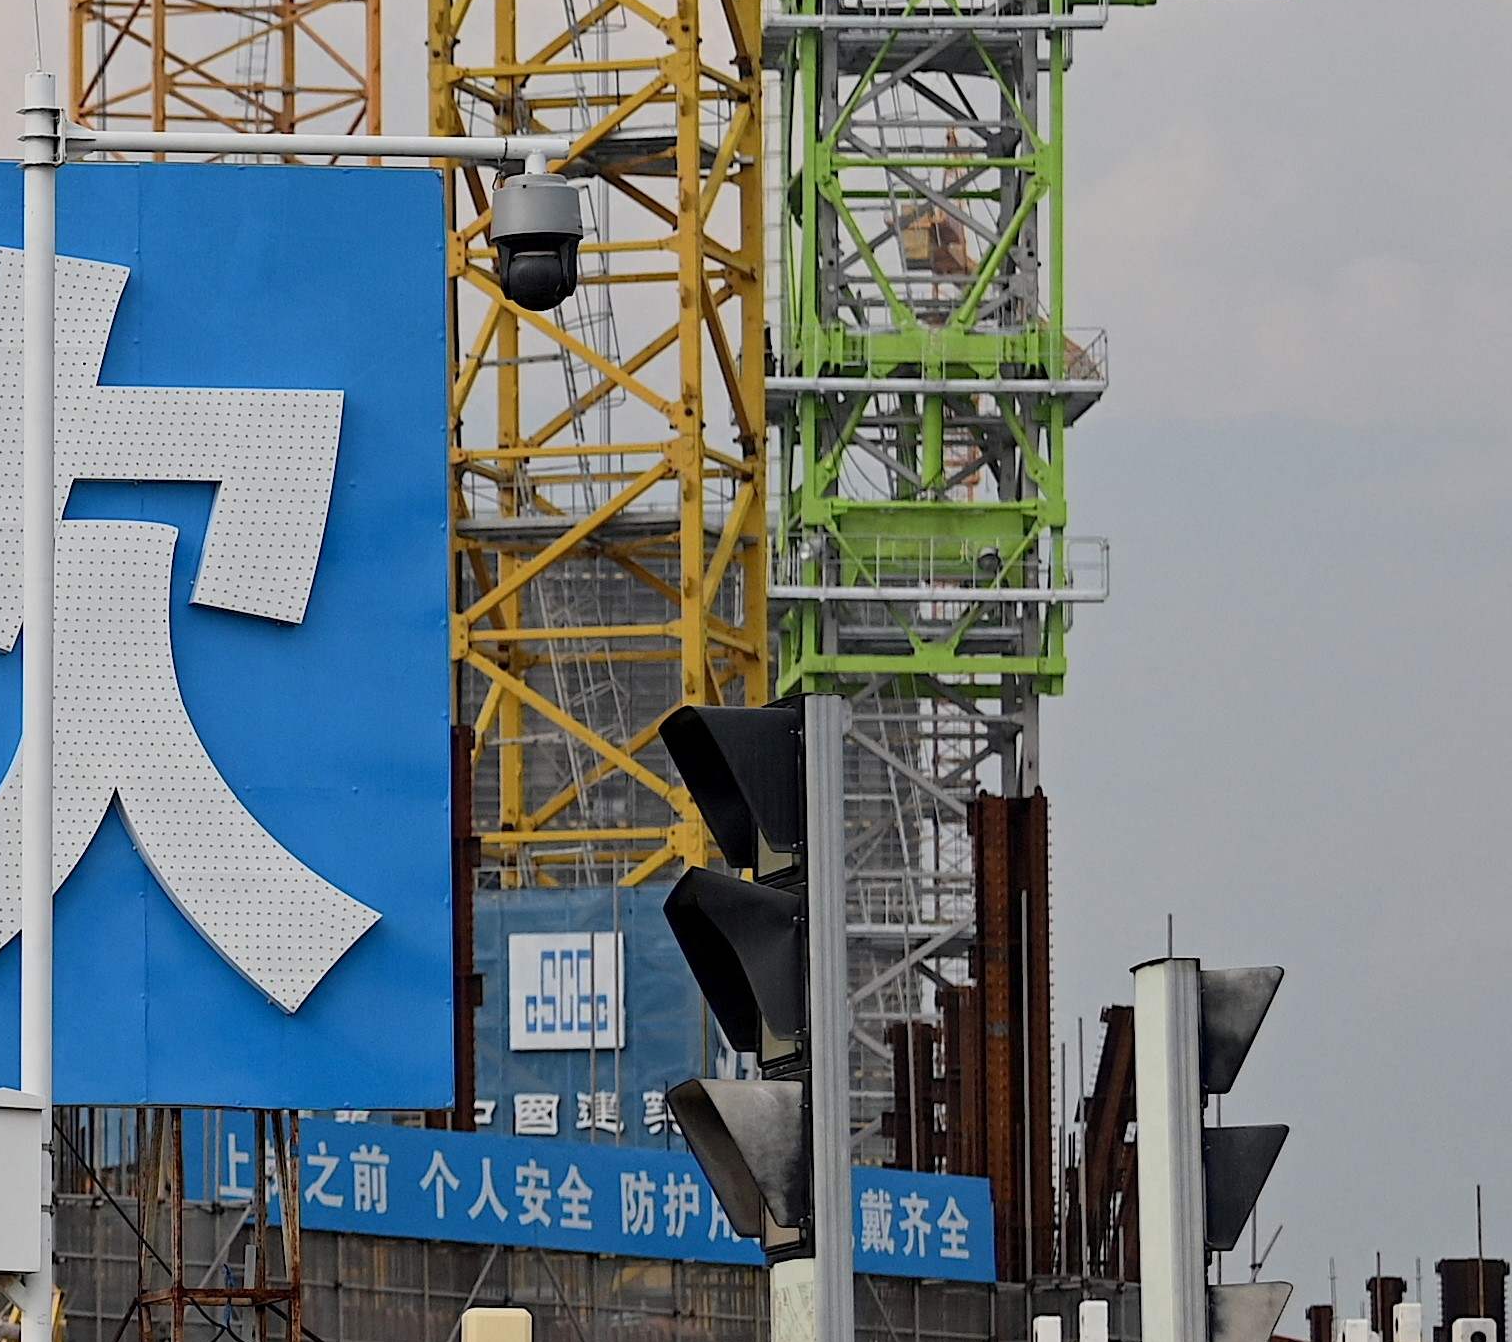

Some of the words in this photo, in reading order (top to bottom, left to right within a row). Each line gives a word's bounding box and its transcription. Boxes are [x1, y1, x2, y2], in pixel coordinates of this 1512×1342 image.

[419, 1149, 594, 1230] 个人安全
[852, 1187, 970, 1260] 戴齐全
